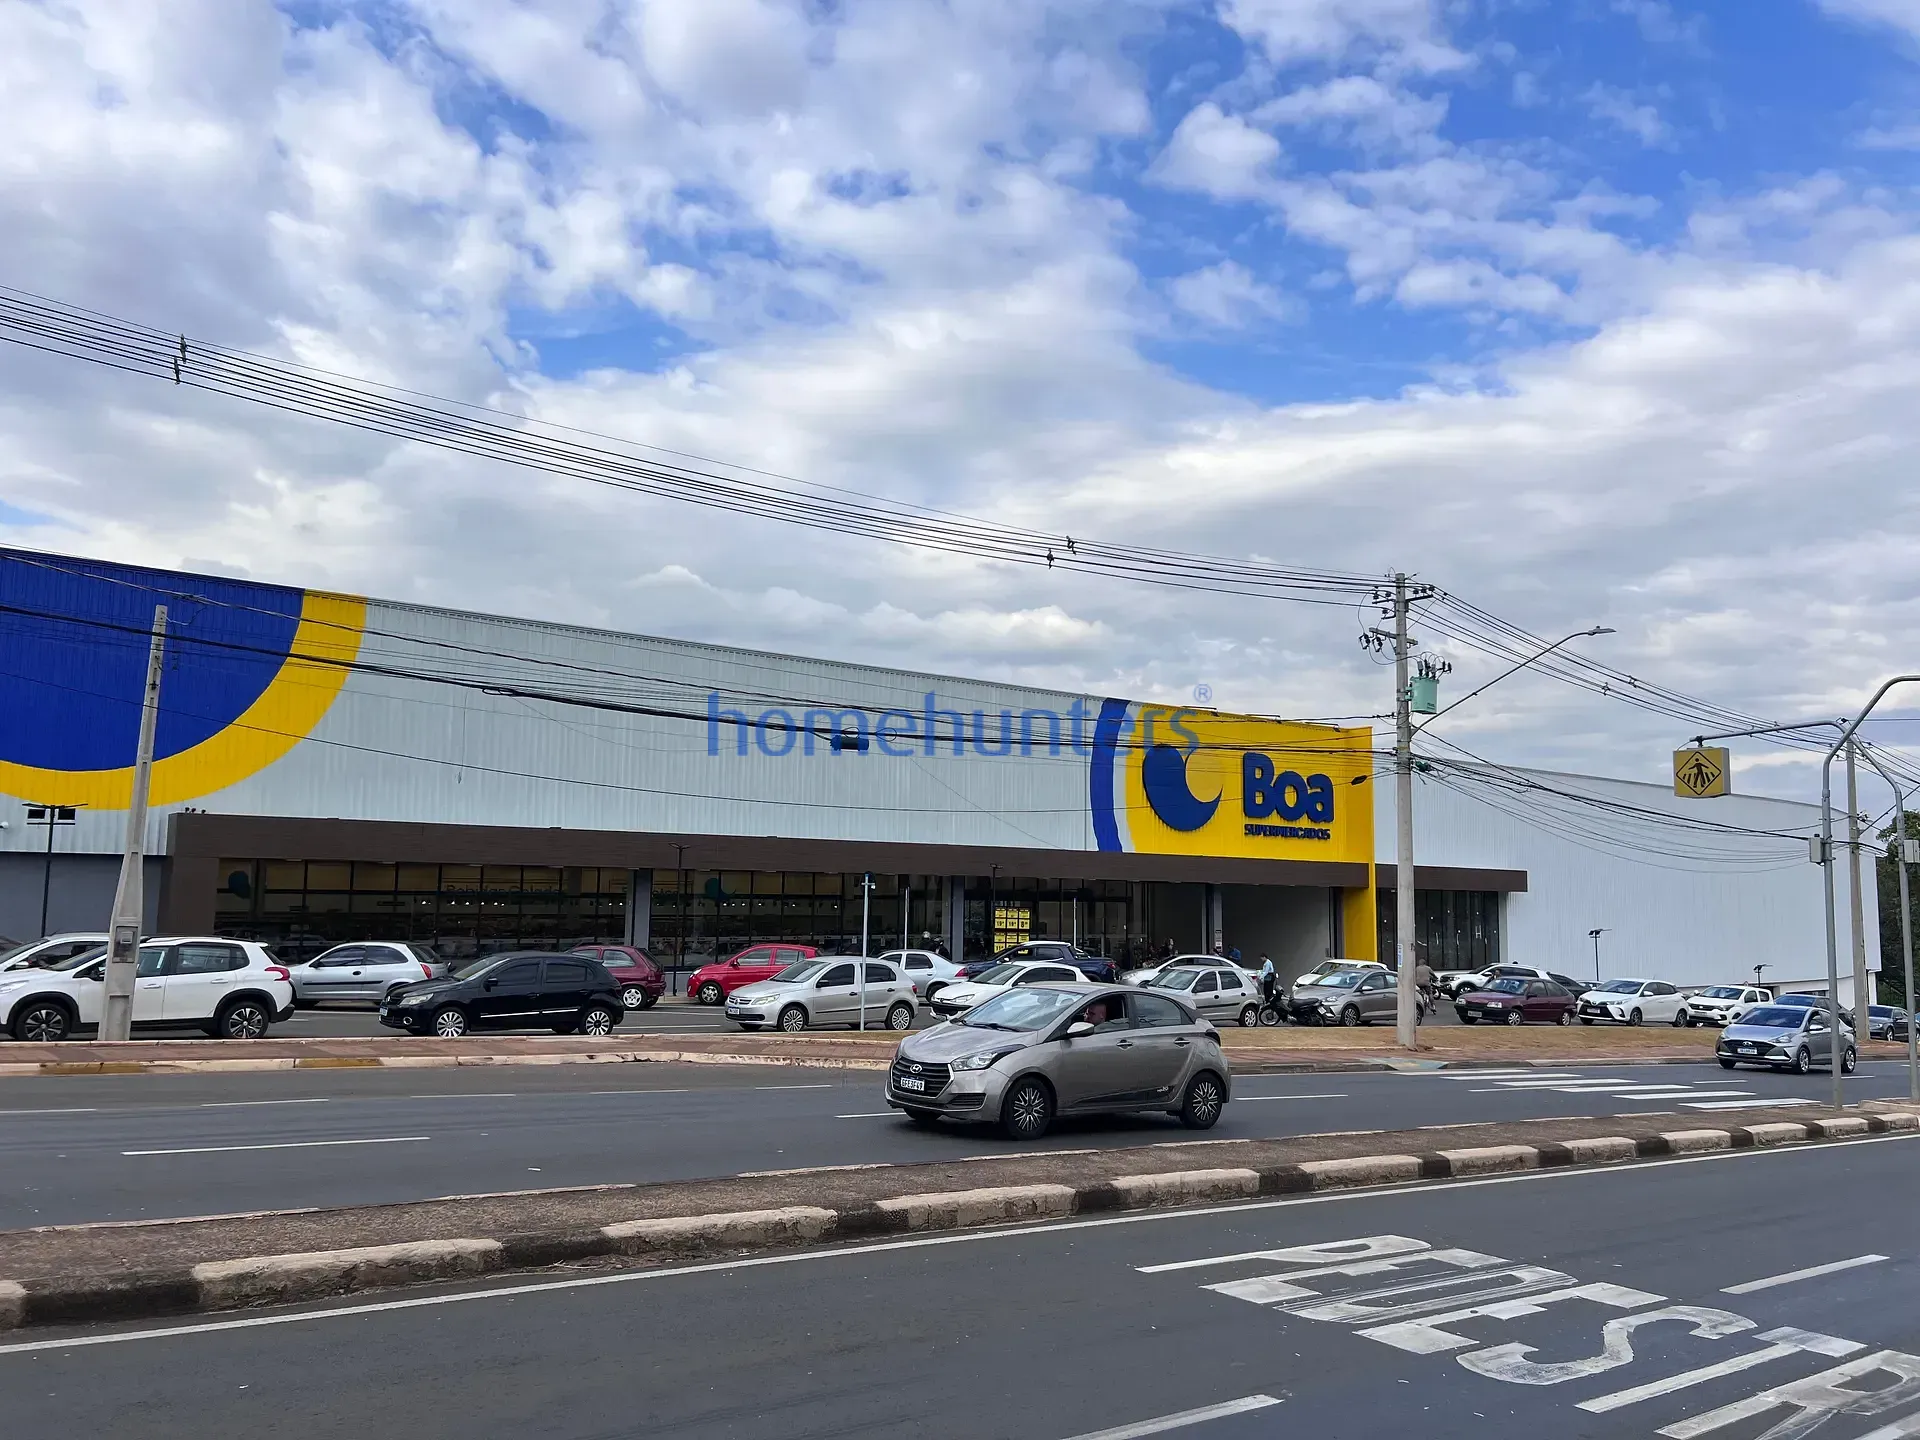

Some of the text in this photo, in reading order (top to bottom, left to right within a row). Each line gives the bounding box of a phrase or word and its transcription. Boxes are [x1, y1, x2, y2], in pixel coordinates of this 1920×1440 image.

[1243, 752, 1335, 823] Boa
[1244, 824, 1331, 840] SUPERMERCADOS
[1135, 1234, 1920, 1440] PEDESTR
